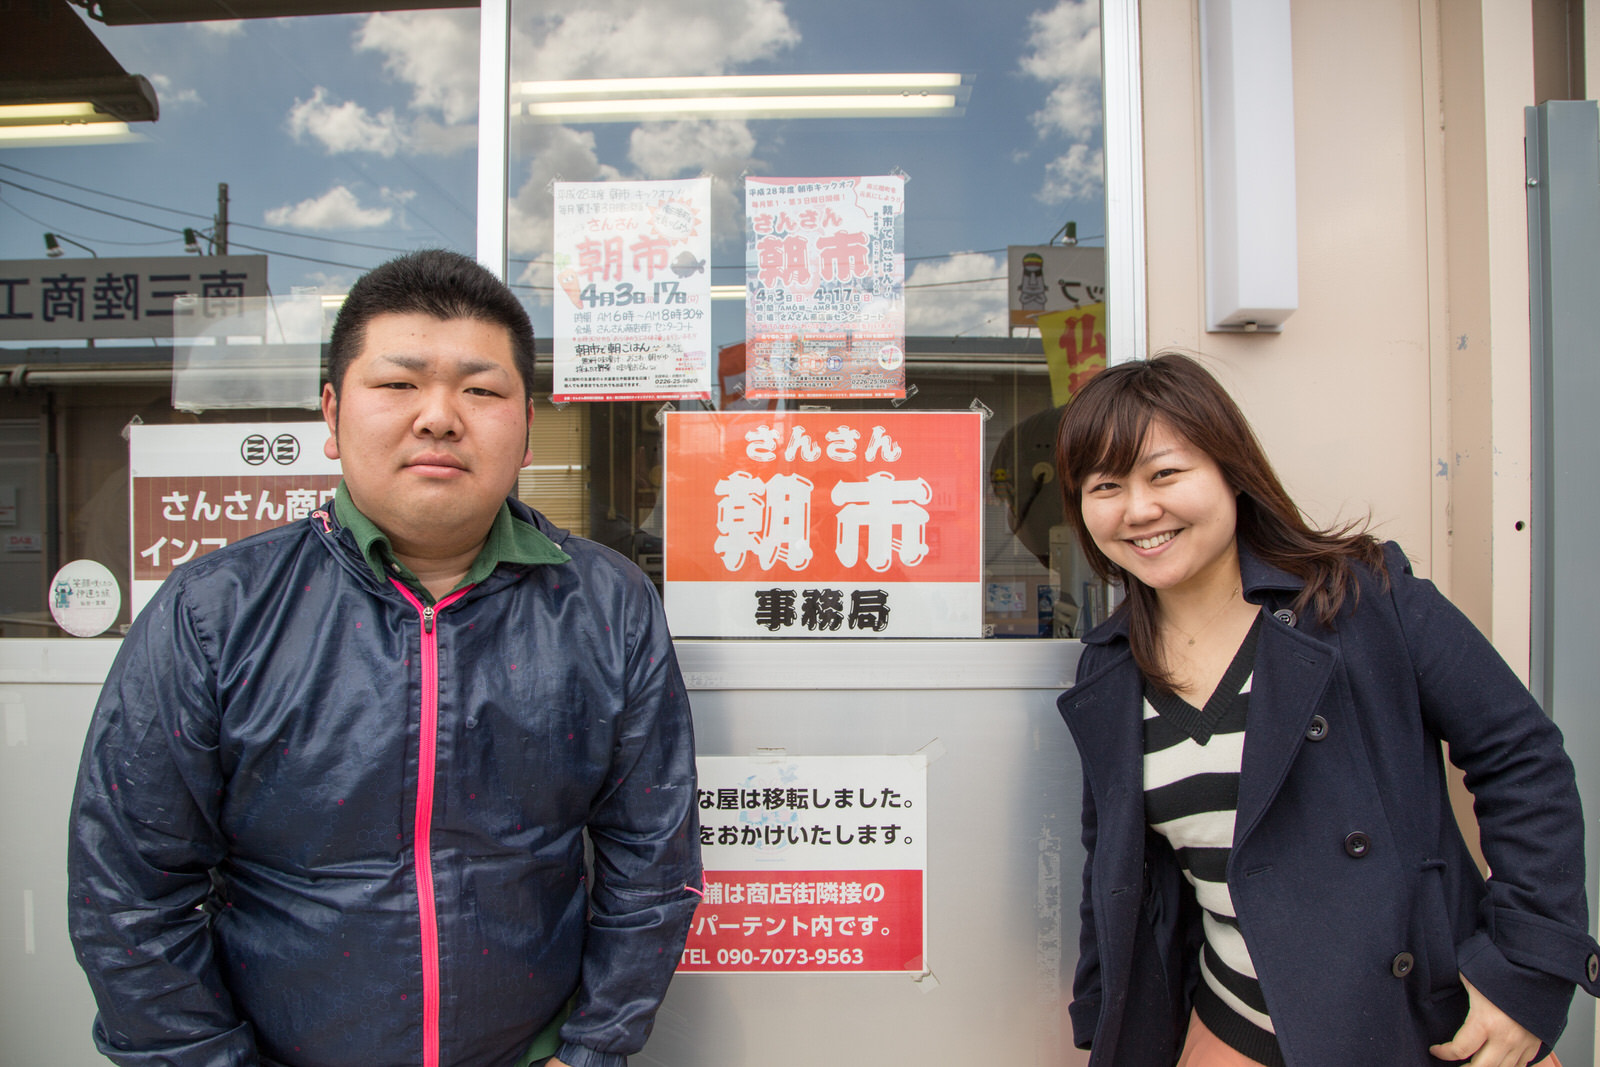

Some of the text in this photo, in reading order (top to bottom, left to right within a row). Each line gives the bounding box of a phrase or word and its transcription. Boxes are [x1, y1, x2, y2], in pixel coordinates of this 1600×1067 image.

[587, 217, 639, 232] さんさん
[753, 208, 843, 233] さんさん
[575, 235, 671, 282] 朝市
[757, 231, 869, 289] 朝市
[746, 425, 902, 463] さんさん
[714, 470, 933, 573] 朝市
[754, 587, 890, 632] 事務局
[697, 788, 913, 810] な屋は移転しました。
[700, 824, 913, 845] をおかけいたします。
[690, 914, 890, 937] パーテント内です。
[681, 948, 864, 965] TEL 090-7073-9563
